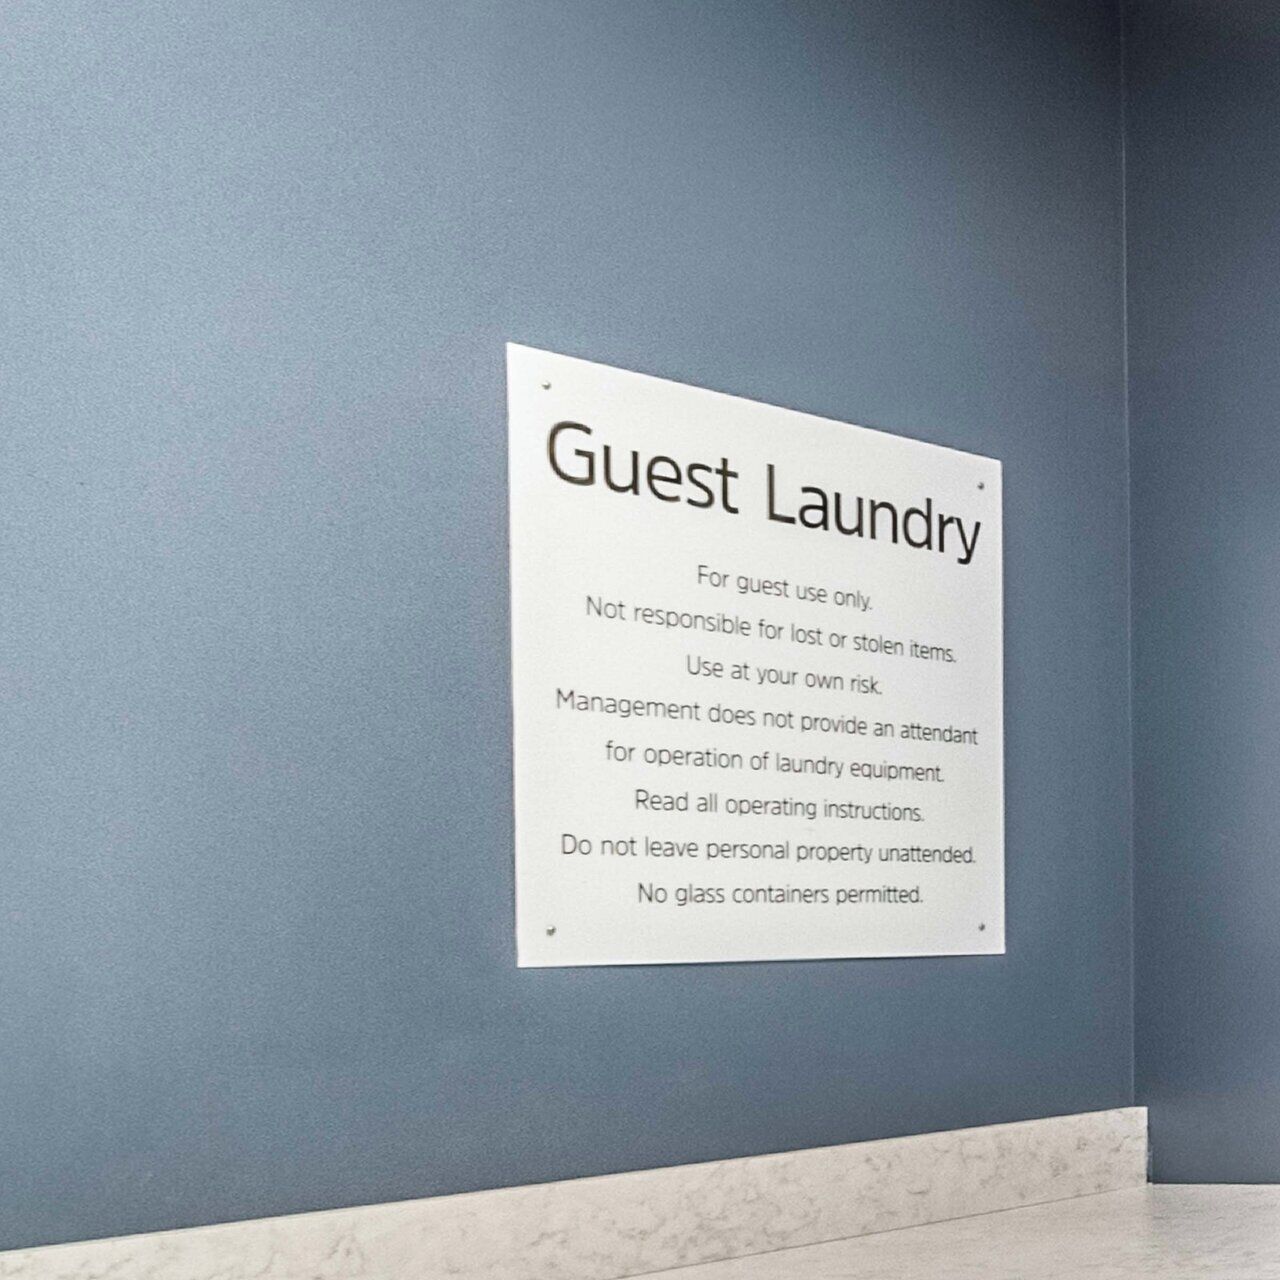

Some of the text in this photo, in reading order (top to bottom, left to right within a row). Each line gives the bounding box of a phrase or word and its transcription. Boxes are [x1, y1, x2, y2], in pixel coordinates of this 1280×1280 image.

[547, 421, 981, 565] Guest Laundry
[697, 564, 873, 612] For guest use only.
[586, 595, 957, 663] Not responsible for lost or stolen items.
[687, 654, 882, 695] Use at your own risk.
[556, 688, 978, 745] Management does not provide an attendant
[605, 740, 944, 783] for operation of laundry equipment.
[635, 788, 924, 822] Read all operating instructions.
[561, 833, 976, 864] Do not leave personal property unattended.
[638, 882, 923, 907] No glass containers permitted.
